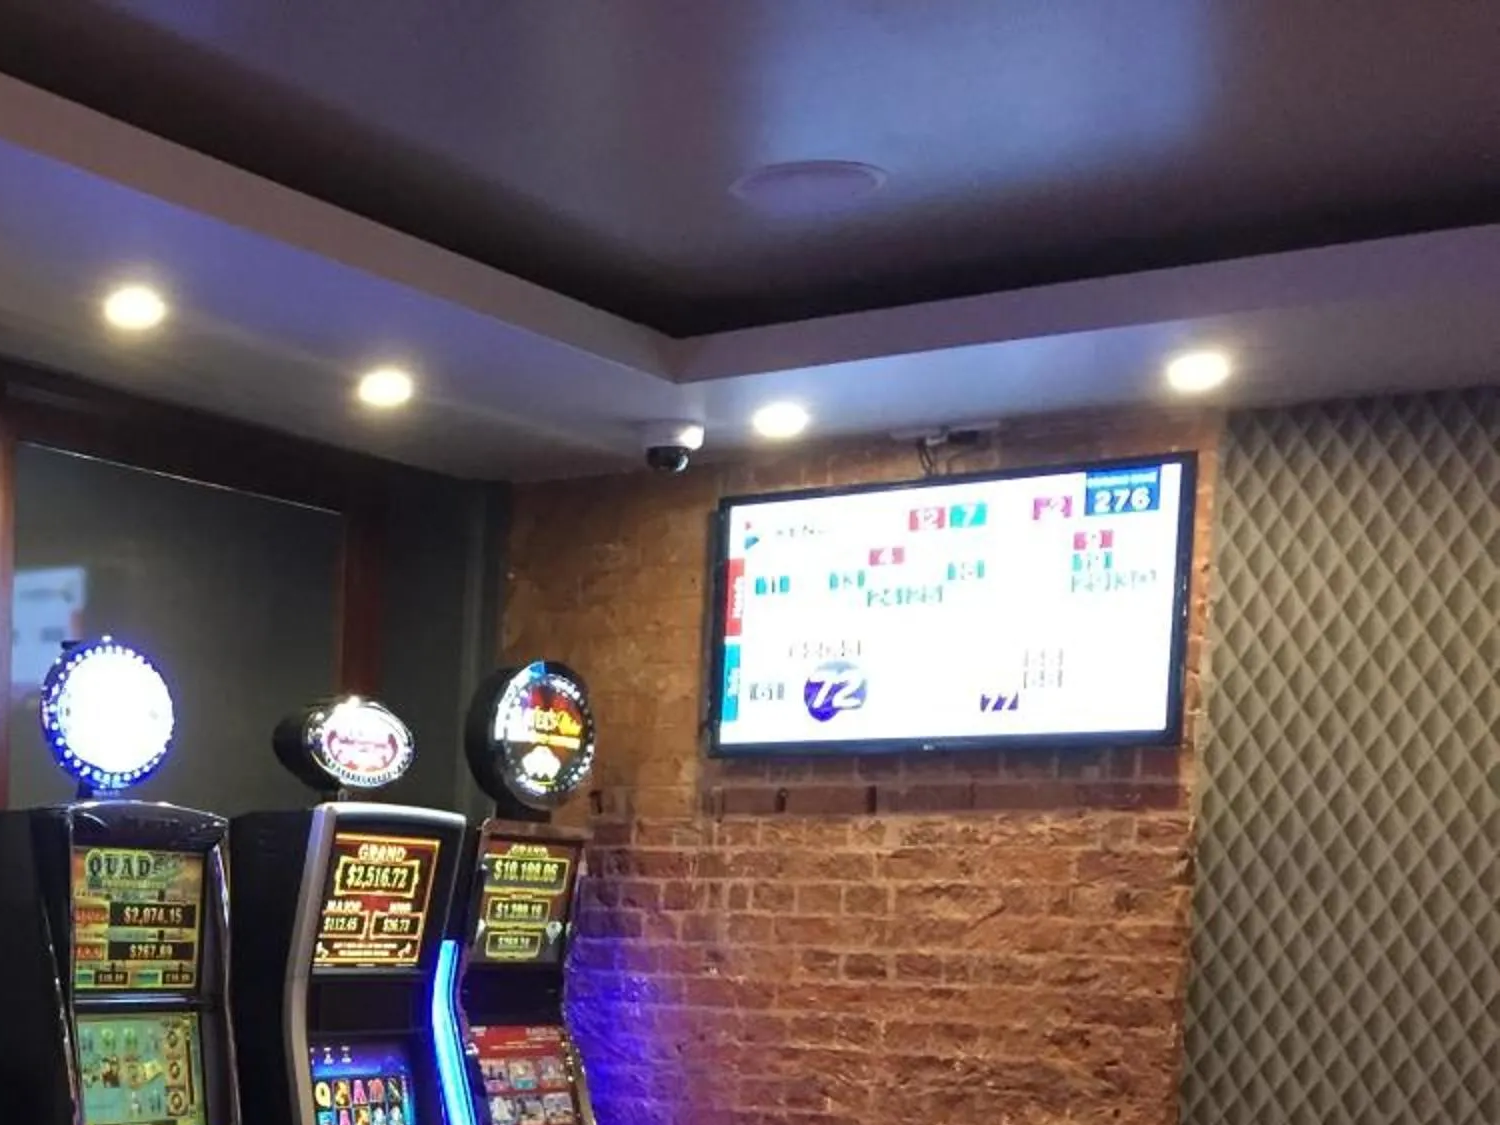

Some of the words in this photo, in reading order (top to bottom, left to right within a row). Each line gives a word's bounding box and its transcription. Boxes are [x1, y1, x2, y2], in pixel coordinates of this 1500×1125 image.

[1094, 487, 1150, 513] 276
[358, 843, 408, 864] GRAND
[88, 855, 150, 877] QUAD
